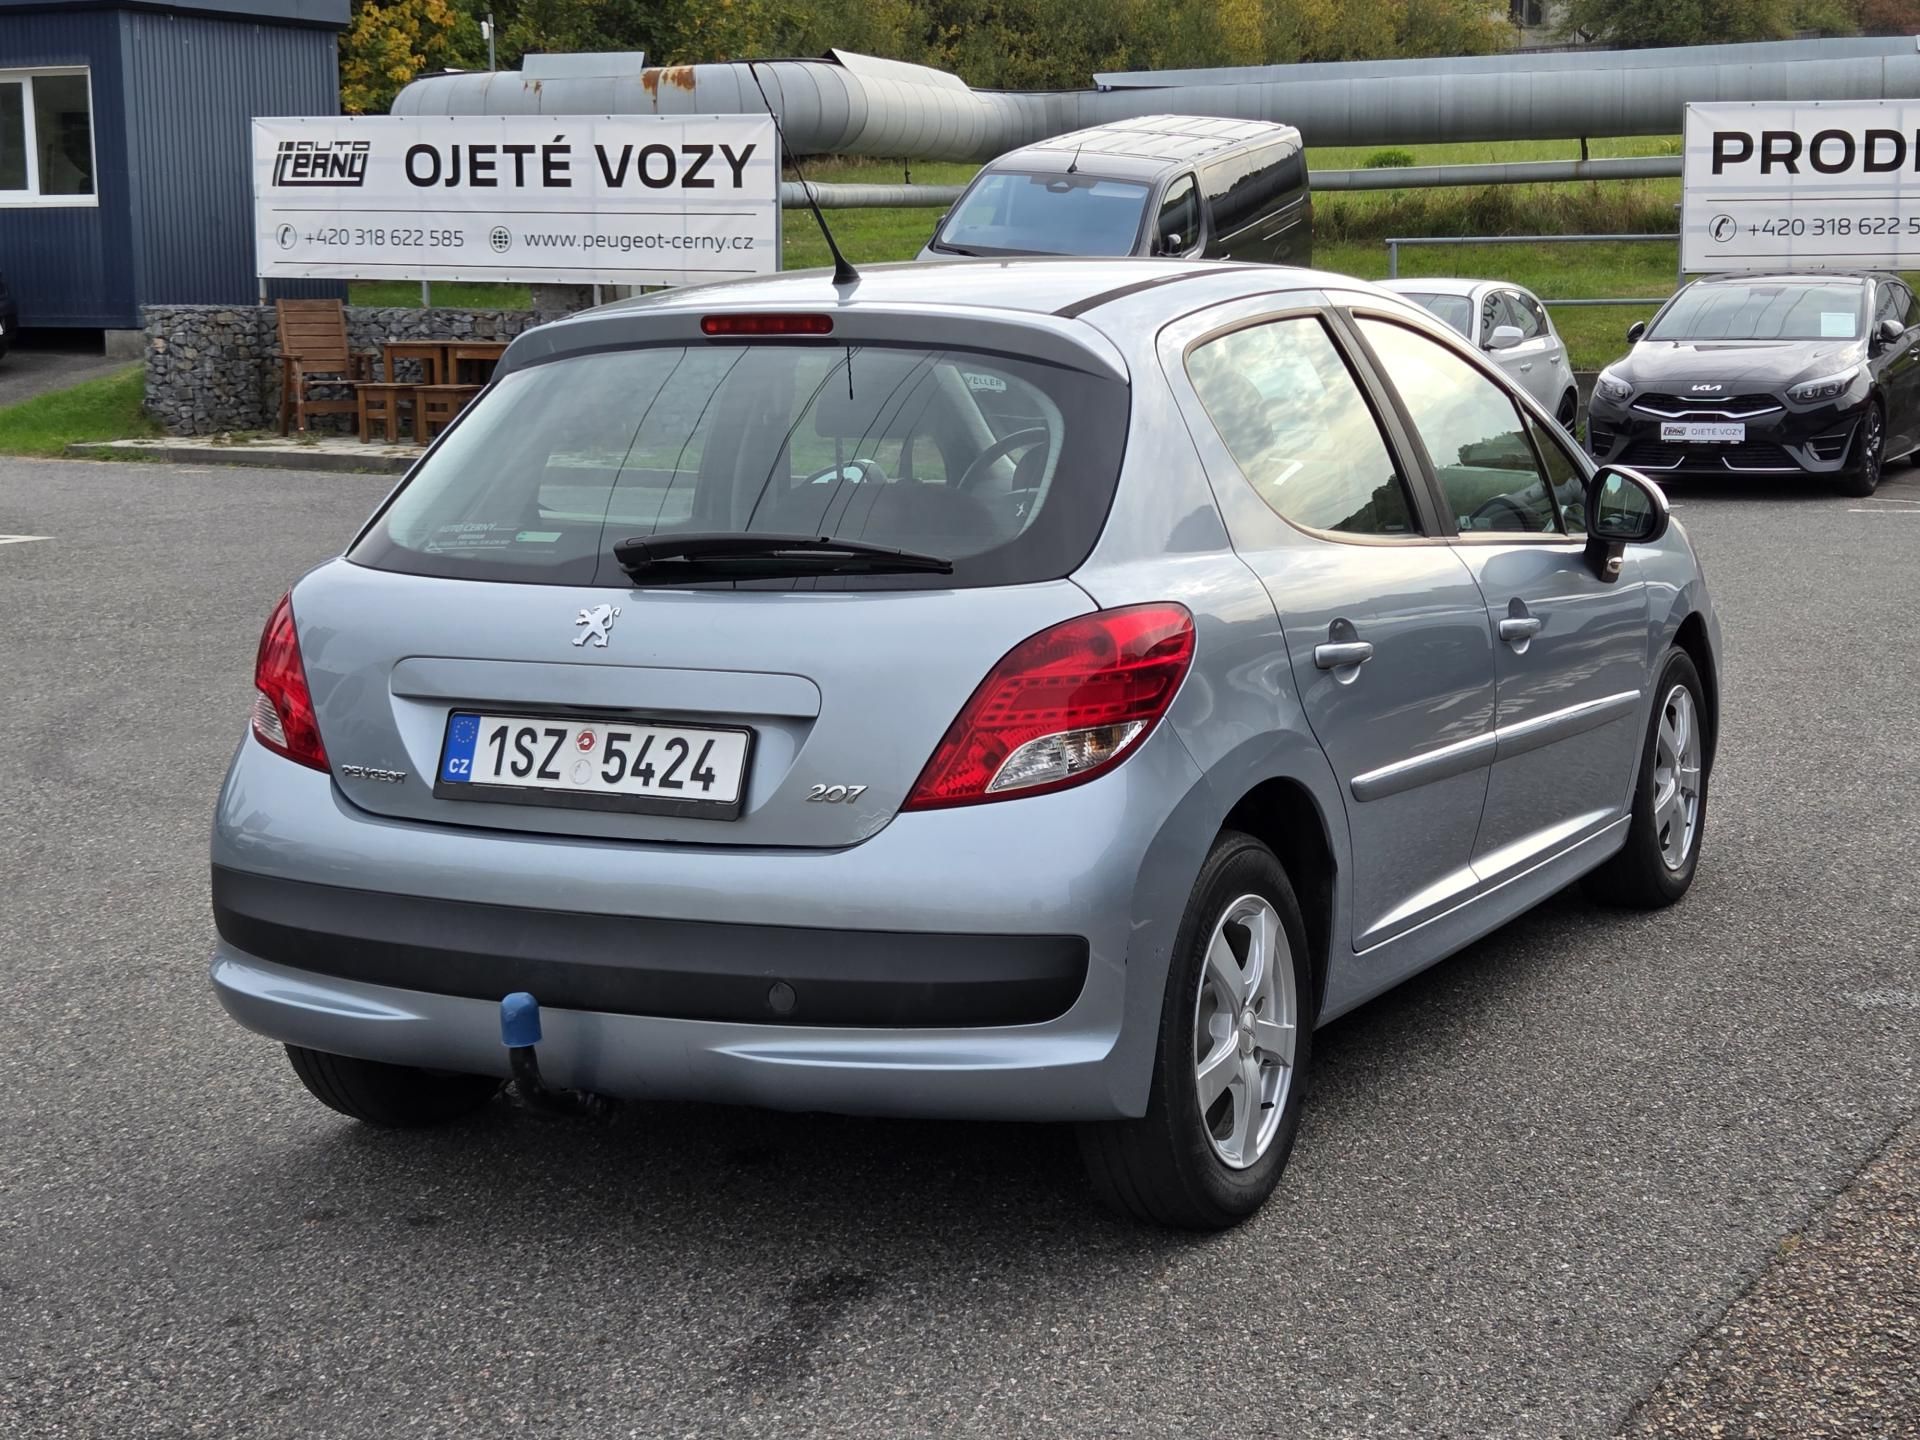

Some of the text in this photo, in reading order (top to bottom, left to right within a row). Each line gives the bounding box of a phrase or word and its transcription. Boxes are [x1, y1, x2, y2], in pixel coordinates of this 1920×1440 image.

[405, 135, 757, 189] OJETÉ VOZY
[1711, 129, 1920, 175] PROD
[1747, 218, 1806, 237] +420
[1812, 218, 1852, 236] 318
[1858, 217, 1901, 236] 622
[304, 229, 465, 248] +420 318 622 585
[524, 233, 754, 254] www.peugeot-cerny.cz
[449, 757, 470, 775] CZ
[488, 725, 716, 791] 1SZ 5424
[341, 764, 408, 784] PEUGEOT
[804, 783, 868, 804] 207
